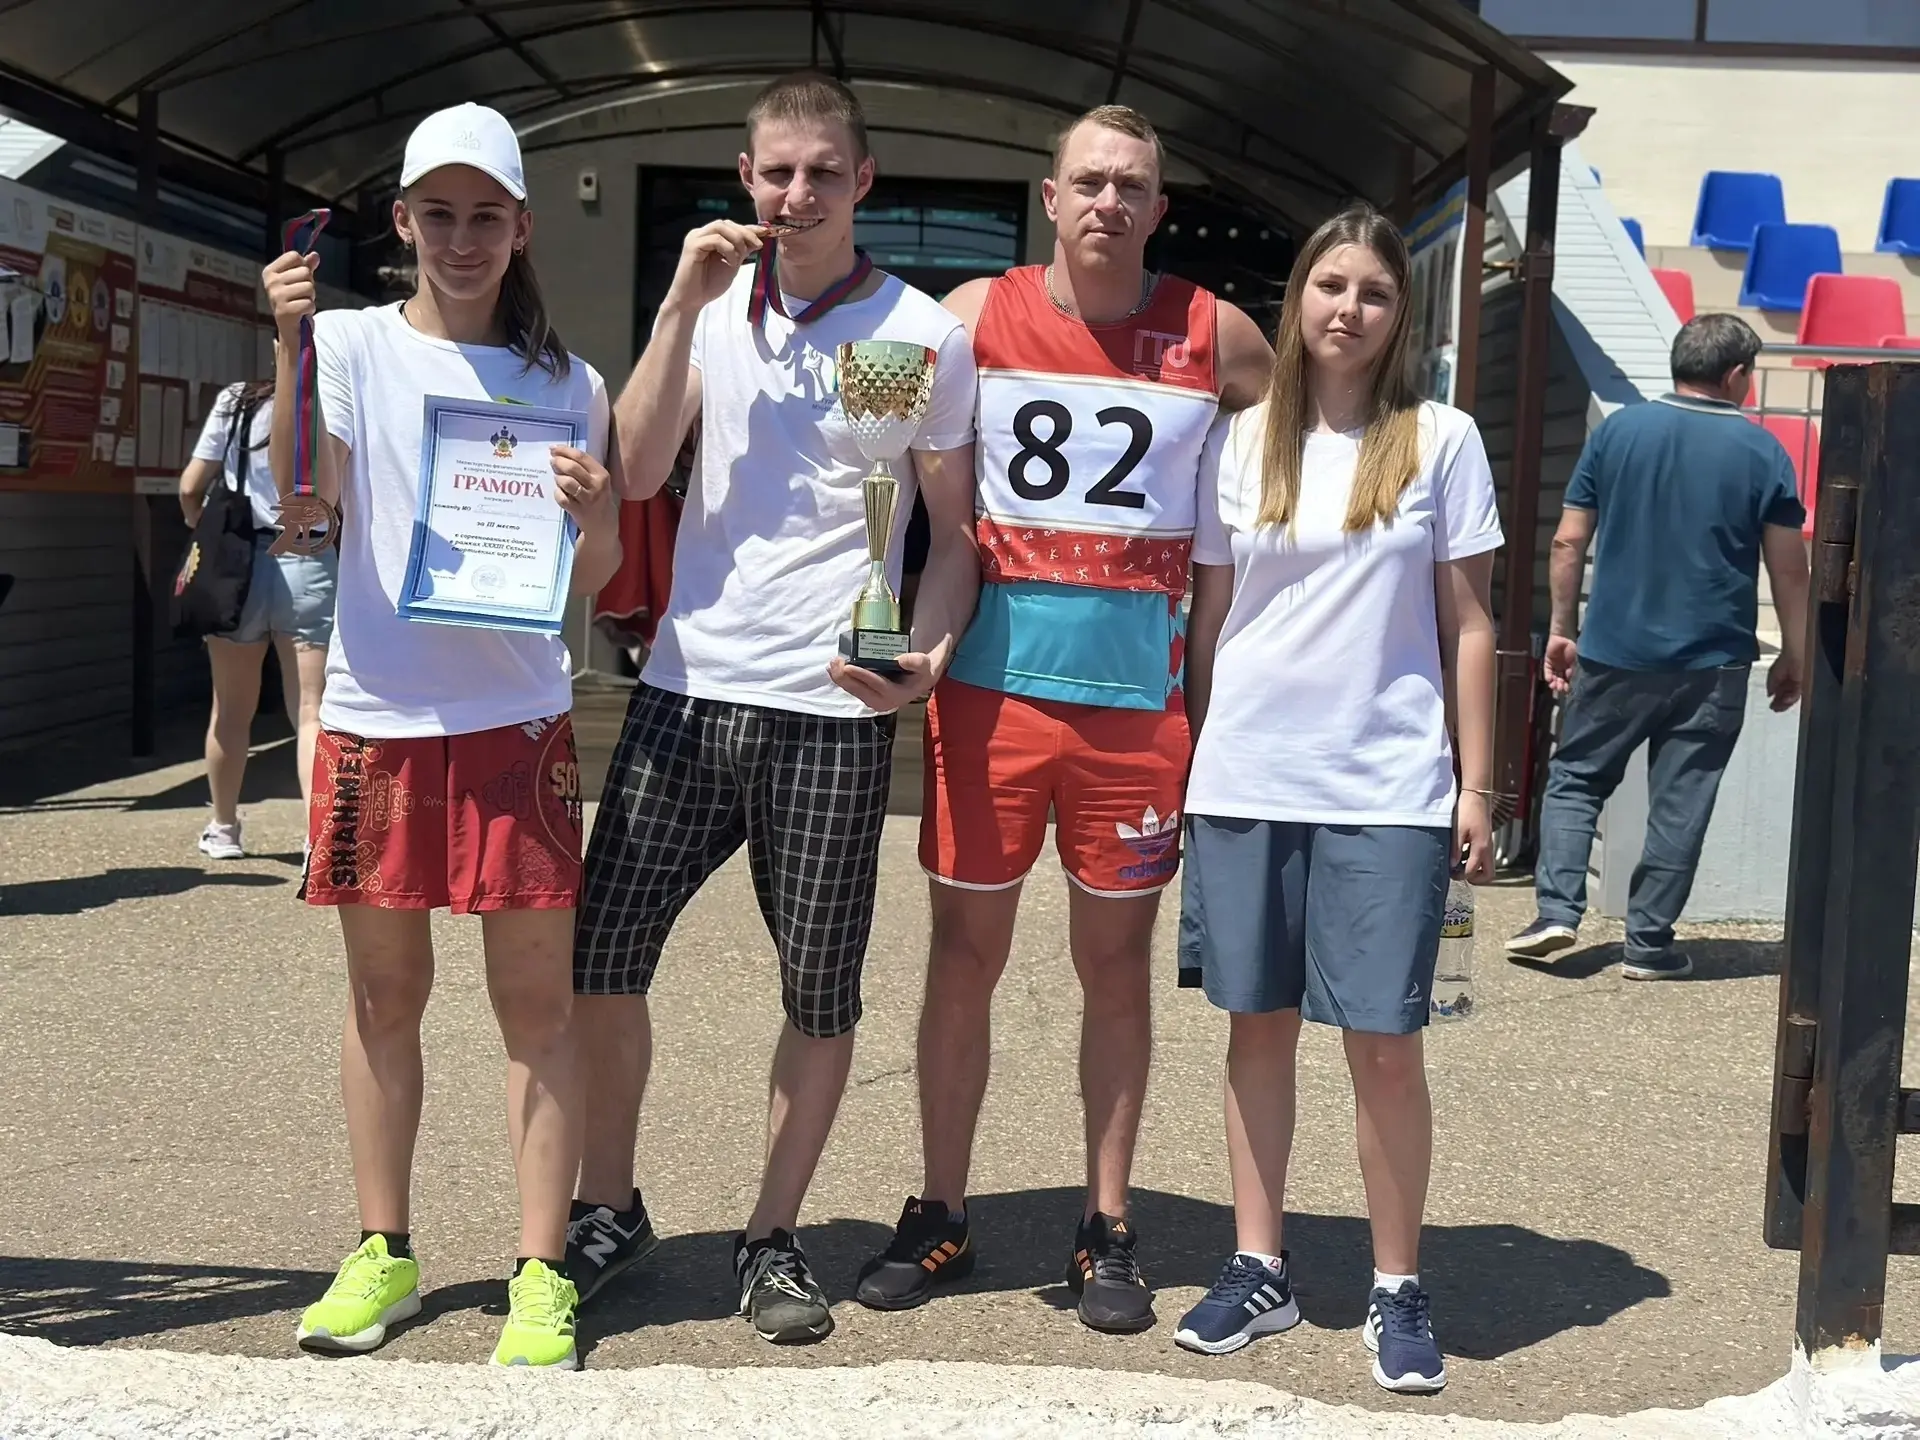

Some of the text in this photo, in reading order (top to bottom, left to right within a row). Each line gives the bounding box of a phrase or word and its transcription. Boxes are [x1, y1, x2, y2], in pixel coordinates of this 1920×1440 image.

[1007, 399, 1153, 509] 82
[453, 473, 545, 499] ГРАМОТА
[434, 504, 460, 512] команду
[496, 523, 521, 531] место
[460, 533, 510, 544] соревнованиях
[455, 540, 481, 548] рамках
[505, 545, 538, 554] Сельских
[496, 551, 510, 559] игр
[510, 551, 537, 560] Кубани
